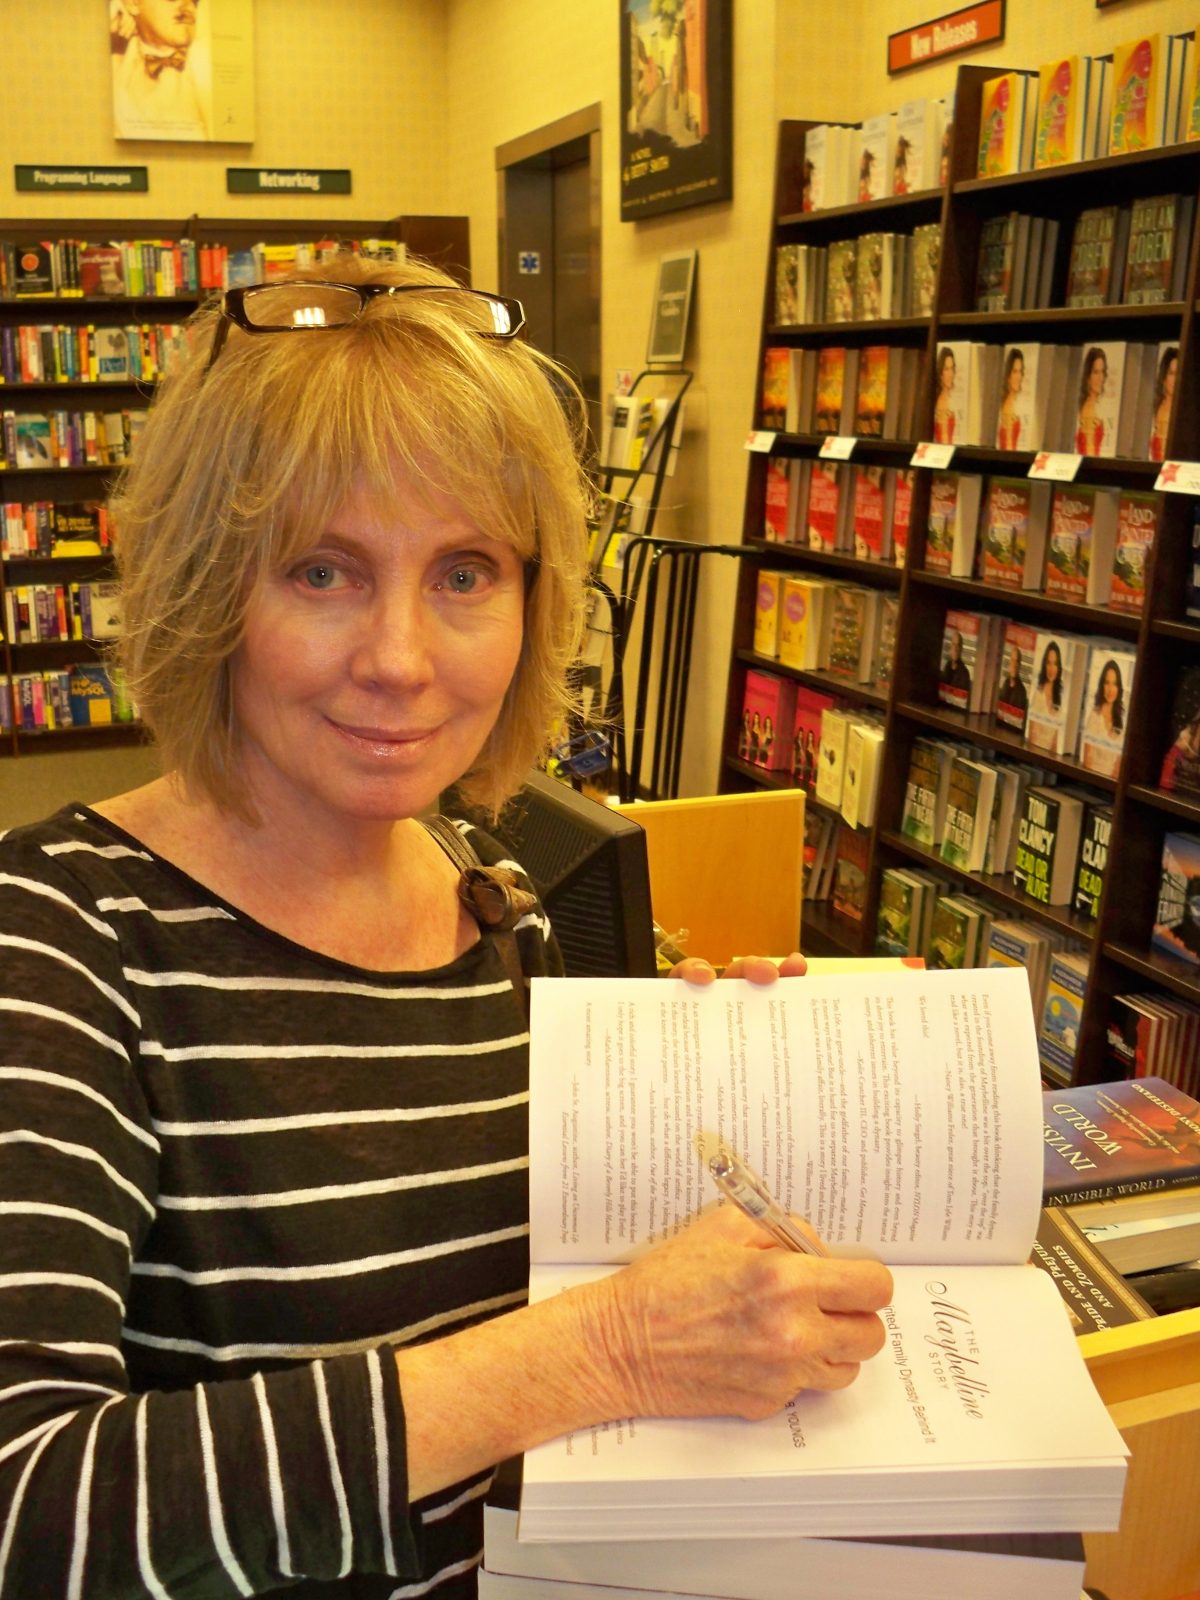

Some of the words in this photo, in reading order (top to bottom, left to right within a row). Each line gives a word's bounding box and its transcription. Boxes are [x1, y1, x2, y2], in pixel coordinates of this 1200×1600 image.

[910, 33, 931, 60] New
[933, 20, 977, 52] Releases
[34, 170, 88, 186] Programming
[90, 171, 131, 186] Languages
[259, 171, 320, 191] Networking
[1028, 797, 1047, 827] TOM
[1019, 818, 1054, 856] CLANCY
[1016, 847, 1035, 874] DEAD
[1035, 858, 1048, 882] OR
[1025, 874, 1049, 903] ALIVE
[1079, 867, 1102, 897] DEAD
[971, 994, 982, 1016] created
[962, 1024, 976, 1052] expected
[975, 1036, 987, 1067] founding
[968, 1054, 977, 1070] from
[985, 1048, 995, 1064] away
[773, 1062, 783, 1096] characters
[881, 1074, 891, 1089] This
[889, 1060, 902, 1086] beyond
[627, 1082, 637, 1114] guarantee
[869, 1090, 882, 1119] building
[880, 1090, 891, 1118] exciting
[967, 1085, 980, 1122] generation
[978, 1077, 991, 1114] Maybelline
[990, 1084, 1002, 1110] reading
[839, 1110, 850, 1144] godfather
[885, 1118, 893, 1136] book
[972, 1122, 981, 1138] that
[993, 1110, 1002, 1124] this
[1052, 1103, 1123, 1157] WORLD
[994, 1124, 1002, 1142] book
[1043, 1121, 1098, 1172] INVIS
[663, 1147, 672, 1176] different
[686, 1140, 695, 1166] learned
[828, 1140, 838, 1167] separate
[883, 1138, 894, 1167] provides
[893, 1138, 905, 1166] glimpse
[912, 1146, 923, 1168] beauty
[970, 1138, 981, 1168] brought
[991, 1143, 1002, 1174] thinking
[784, 1154, 795, 1182] making
[882, 1168, 894, 1192] insight
[894, 1167, 905, 1190] history
[993, 1174, 1002, 1188] that
[828, 1168, 839, 1204] Maybelline
[1048, 1186, 1115, 1206] INVISIBLE
[1117, 1178, 1166, 1196] WORLD
[988, 1200, 1001, 1219] family
[1052, 1244, 1094, 1288] ZOMBIES
[1062, 1279, 1086, 1301] AND
[1089, 1287, 1114, 1309] AND
[882, 1304, 901, 1331] irited
[1080, 1300, 1111, 1332] PRIDE
[888, 1332, 908, 1367] Family
[923, 1280, 991, 1420] Maybelline
[964, 1329, 980, 1355] THE
[928, 1352, 950, 1390] STORY
[899, 1369, 920, 1403] Dynasty
[786, 1411, 806, 1449] YOUNGS
[912, 1405, 934, 1435] Behind
